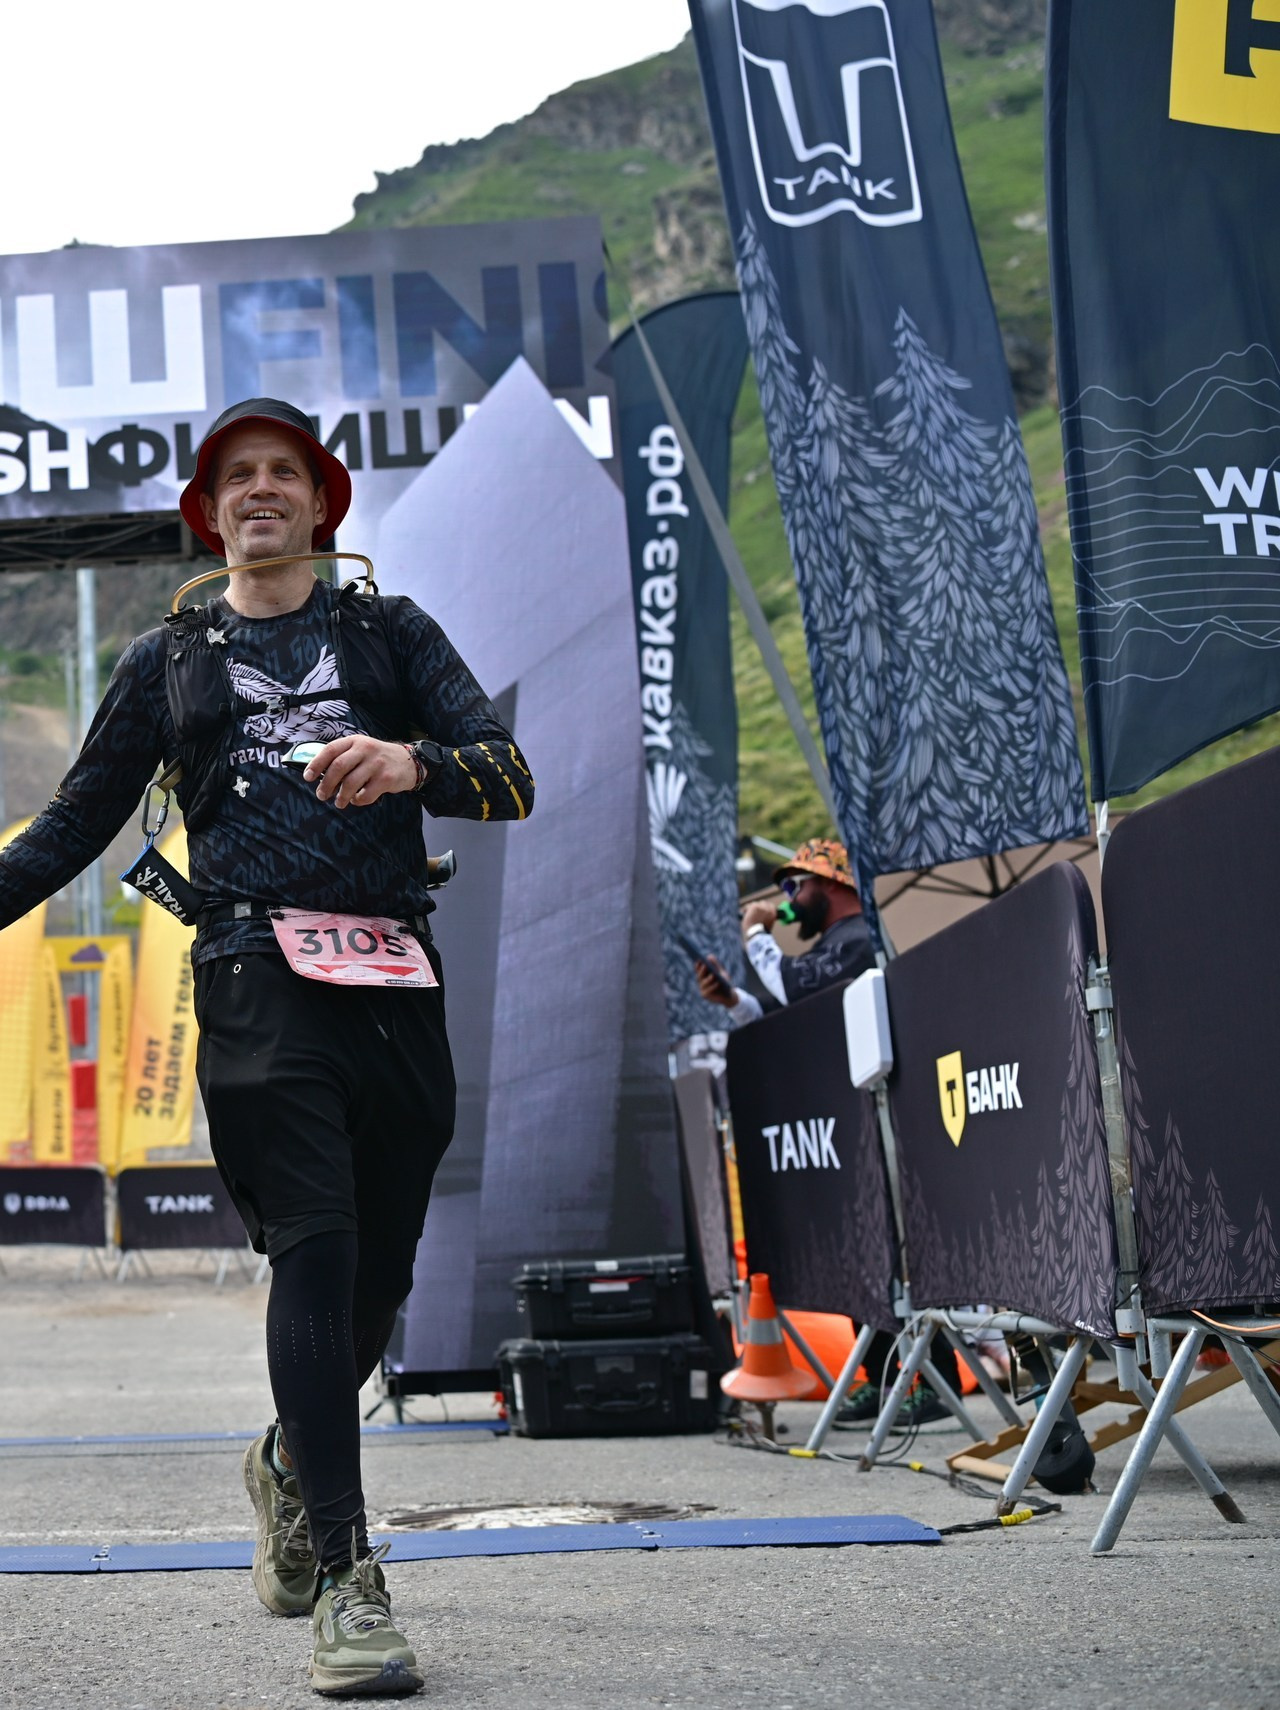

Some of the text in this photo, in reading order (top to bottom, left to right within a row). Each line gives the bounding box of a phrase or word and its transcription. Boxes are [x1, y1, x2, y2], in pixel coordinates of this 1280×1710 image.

[773, 165, 897, 200] TANK
[219, 262, 618, 400] FINI
[294, 928, 408, 957] 3105
[135, 1036, 162, 1118] 20 лет
[966, 1062, 1023, 1115] БАНК
[762, 1117, 841, 1172] TANK
[145, 1194, 214, 1214] TANK
